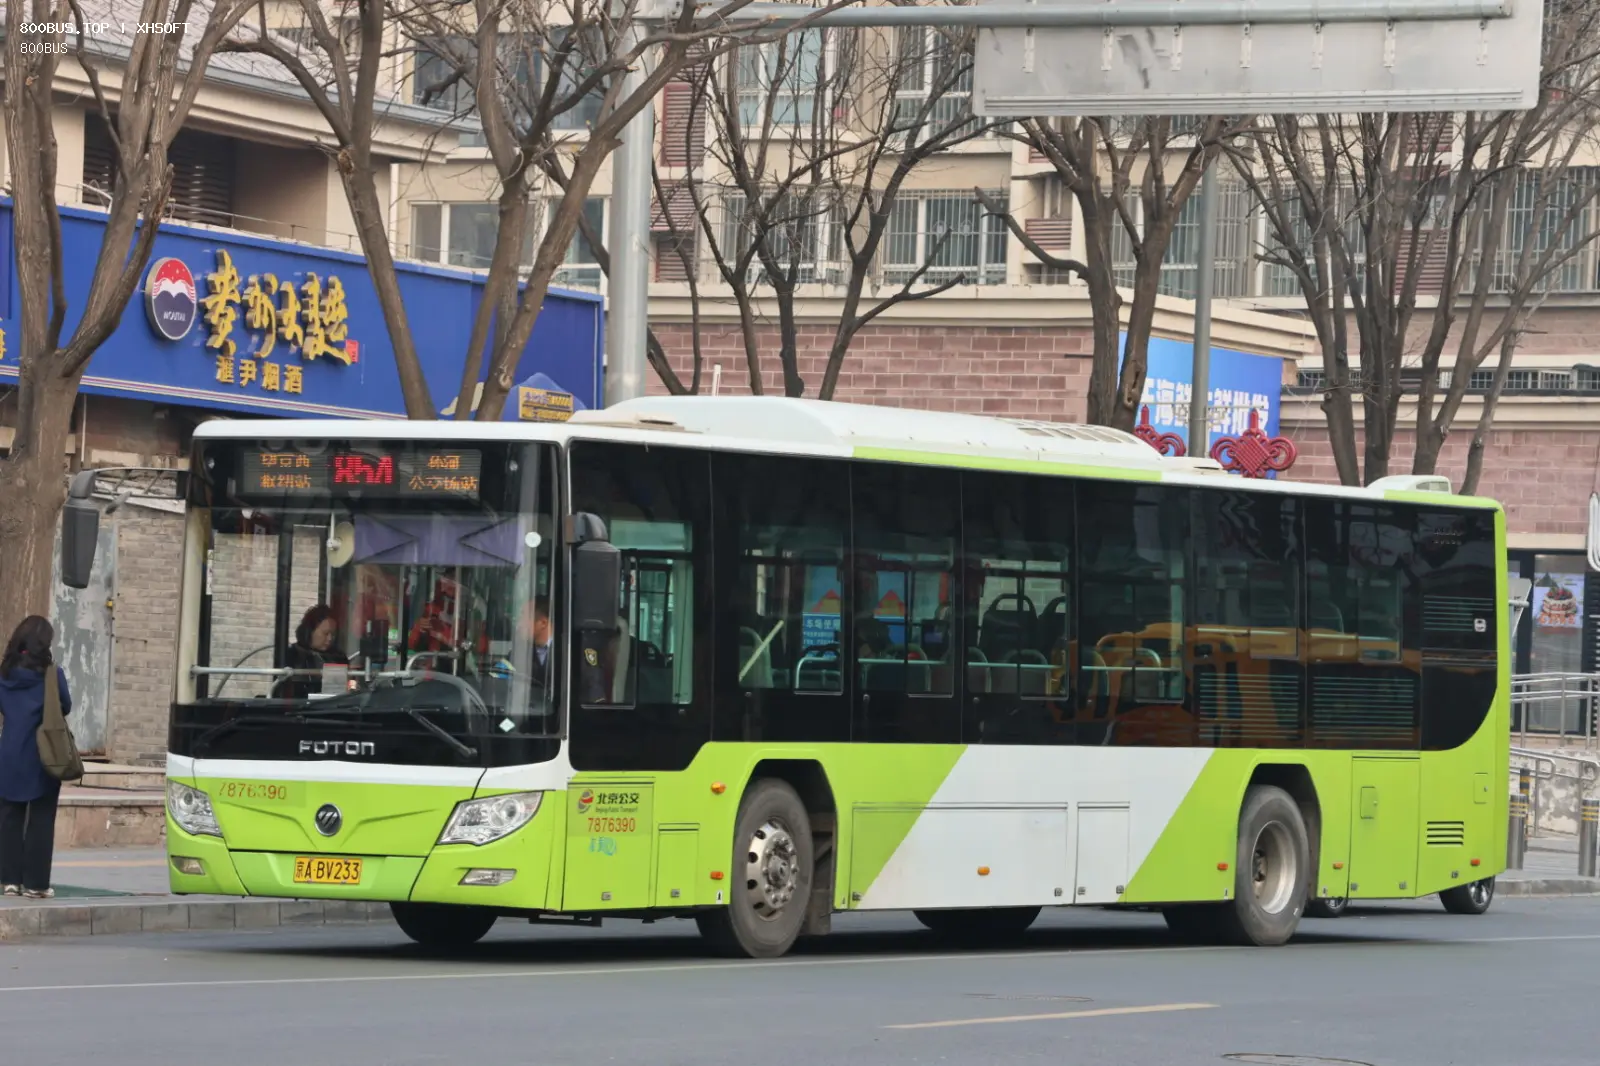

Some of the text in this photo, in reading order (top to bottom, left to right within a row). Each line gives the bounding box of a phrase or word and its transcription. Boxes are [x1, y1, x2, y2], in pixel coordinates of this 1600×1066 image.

[298, 740, 375, 756] FOTON
[596, 792, 640, 805] 北京公交
[587, 816, 636, 833] 7876390
